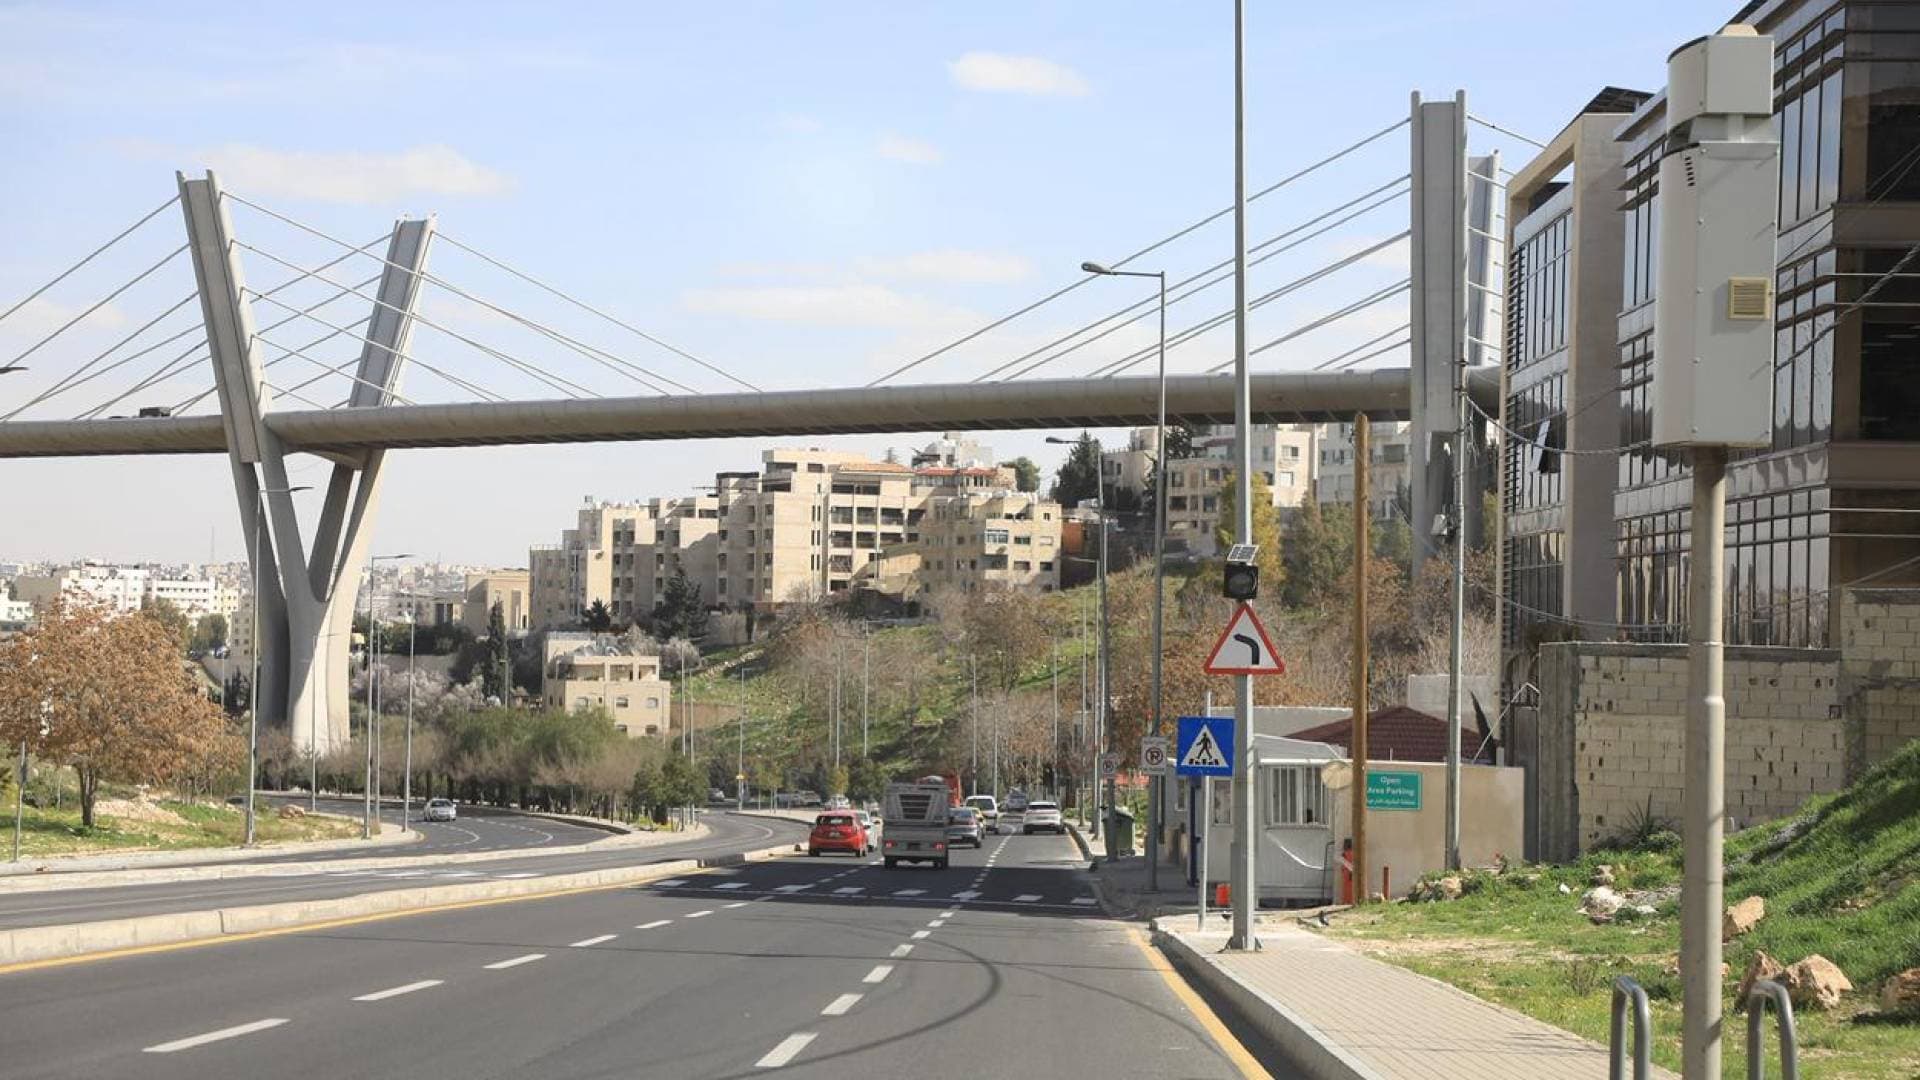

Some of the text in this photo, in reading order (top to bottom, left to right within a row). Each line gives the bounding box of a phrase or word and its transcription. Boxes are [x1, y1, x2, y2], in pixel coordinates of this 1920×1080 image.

[1380, 775, 1401, 785] Open
[1367, 786, 1415, 797] Area Parking
